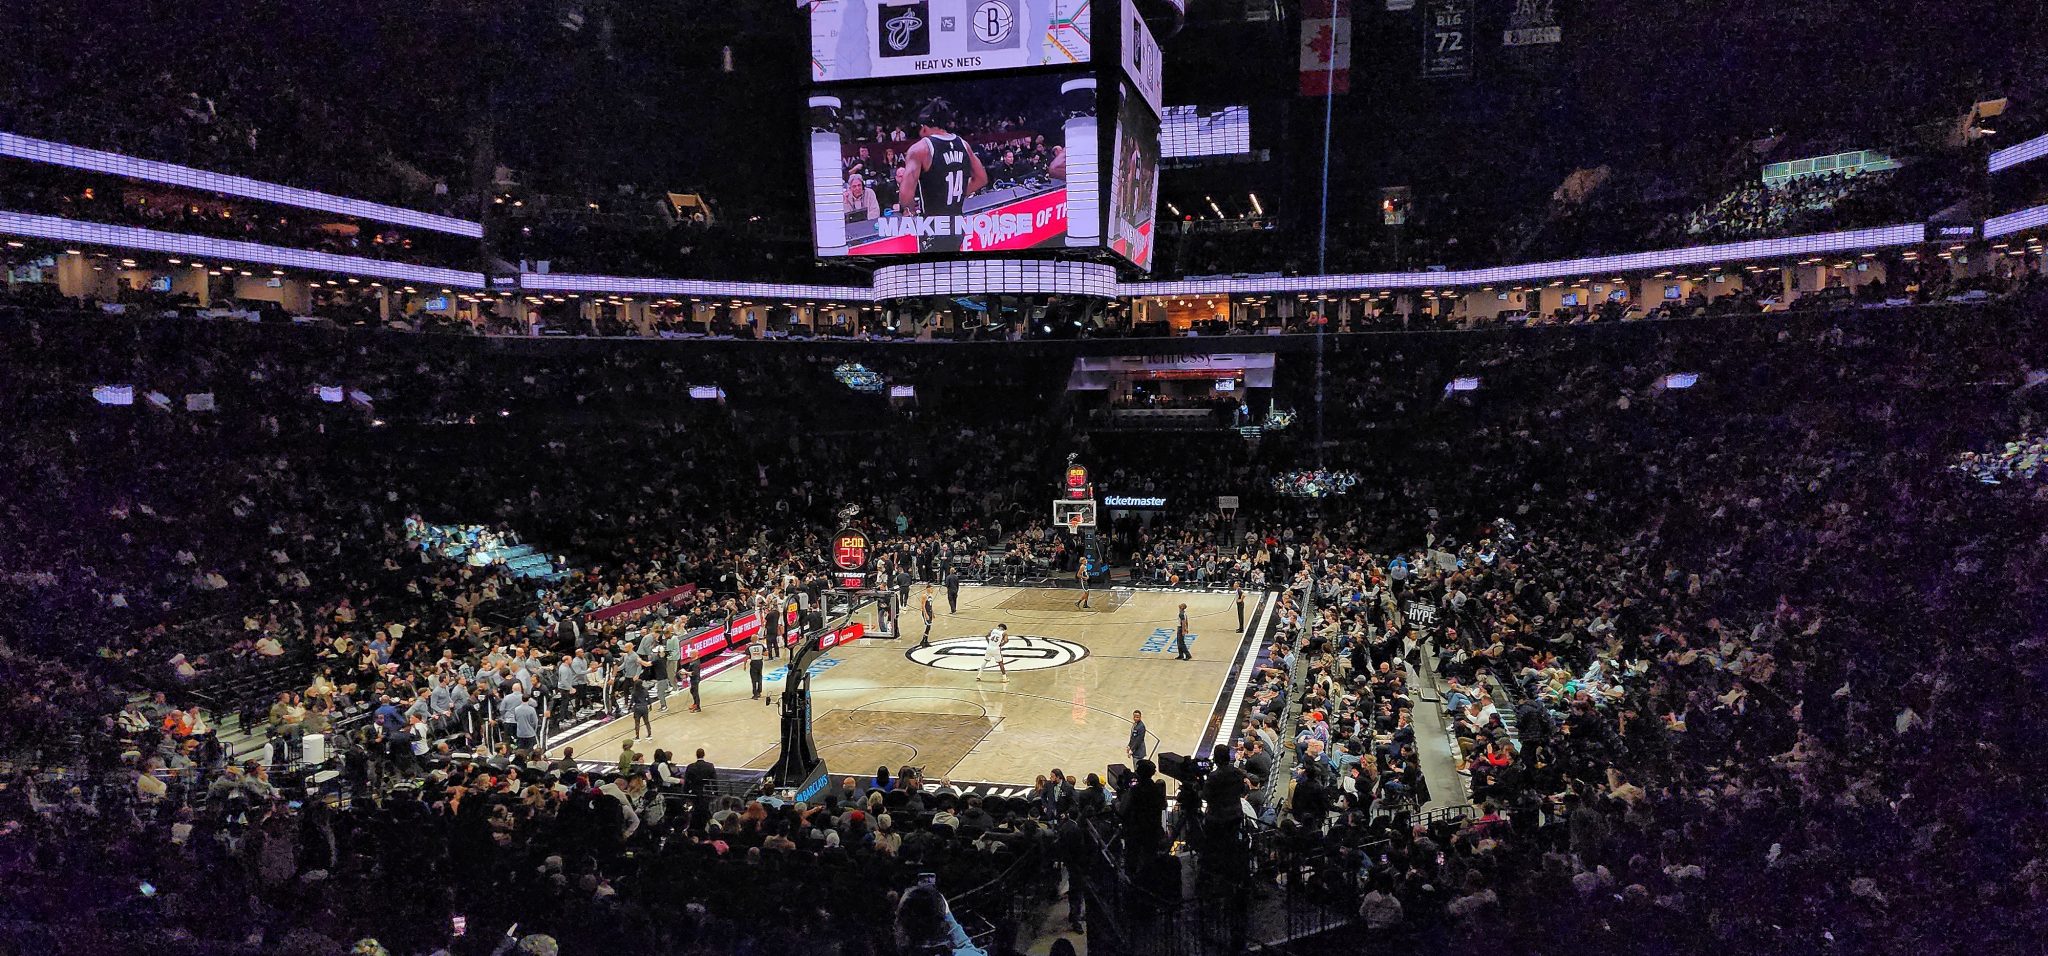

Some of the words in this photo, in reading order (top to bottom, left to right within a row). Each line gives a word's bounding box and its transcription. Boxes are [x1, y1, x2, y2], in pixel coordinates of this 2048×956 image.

[1435, 31, 1463, 52] 72
[915, 60, 939, 71] HEAT
[941, 58, 954, 69] VS
[957, 56, 981, 68] NETS
[946, 170, 963, 206] 14
[878, 216, 950, 237] MAKE
[955, 213, 1033, 236] NOISE
[1036, 208, 1053, 228] OF
[1105, 496, 1166, 505] ticketmaster
[842, 537, 864, 548] 12:00
[840, 547, 862, 565] 24
[1409, 608, 1434, 623] HYPE
[803, 775, 828, 801] BARCLAYS
